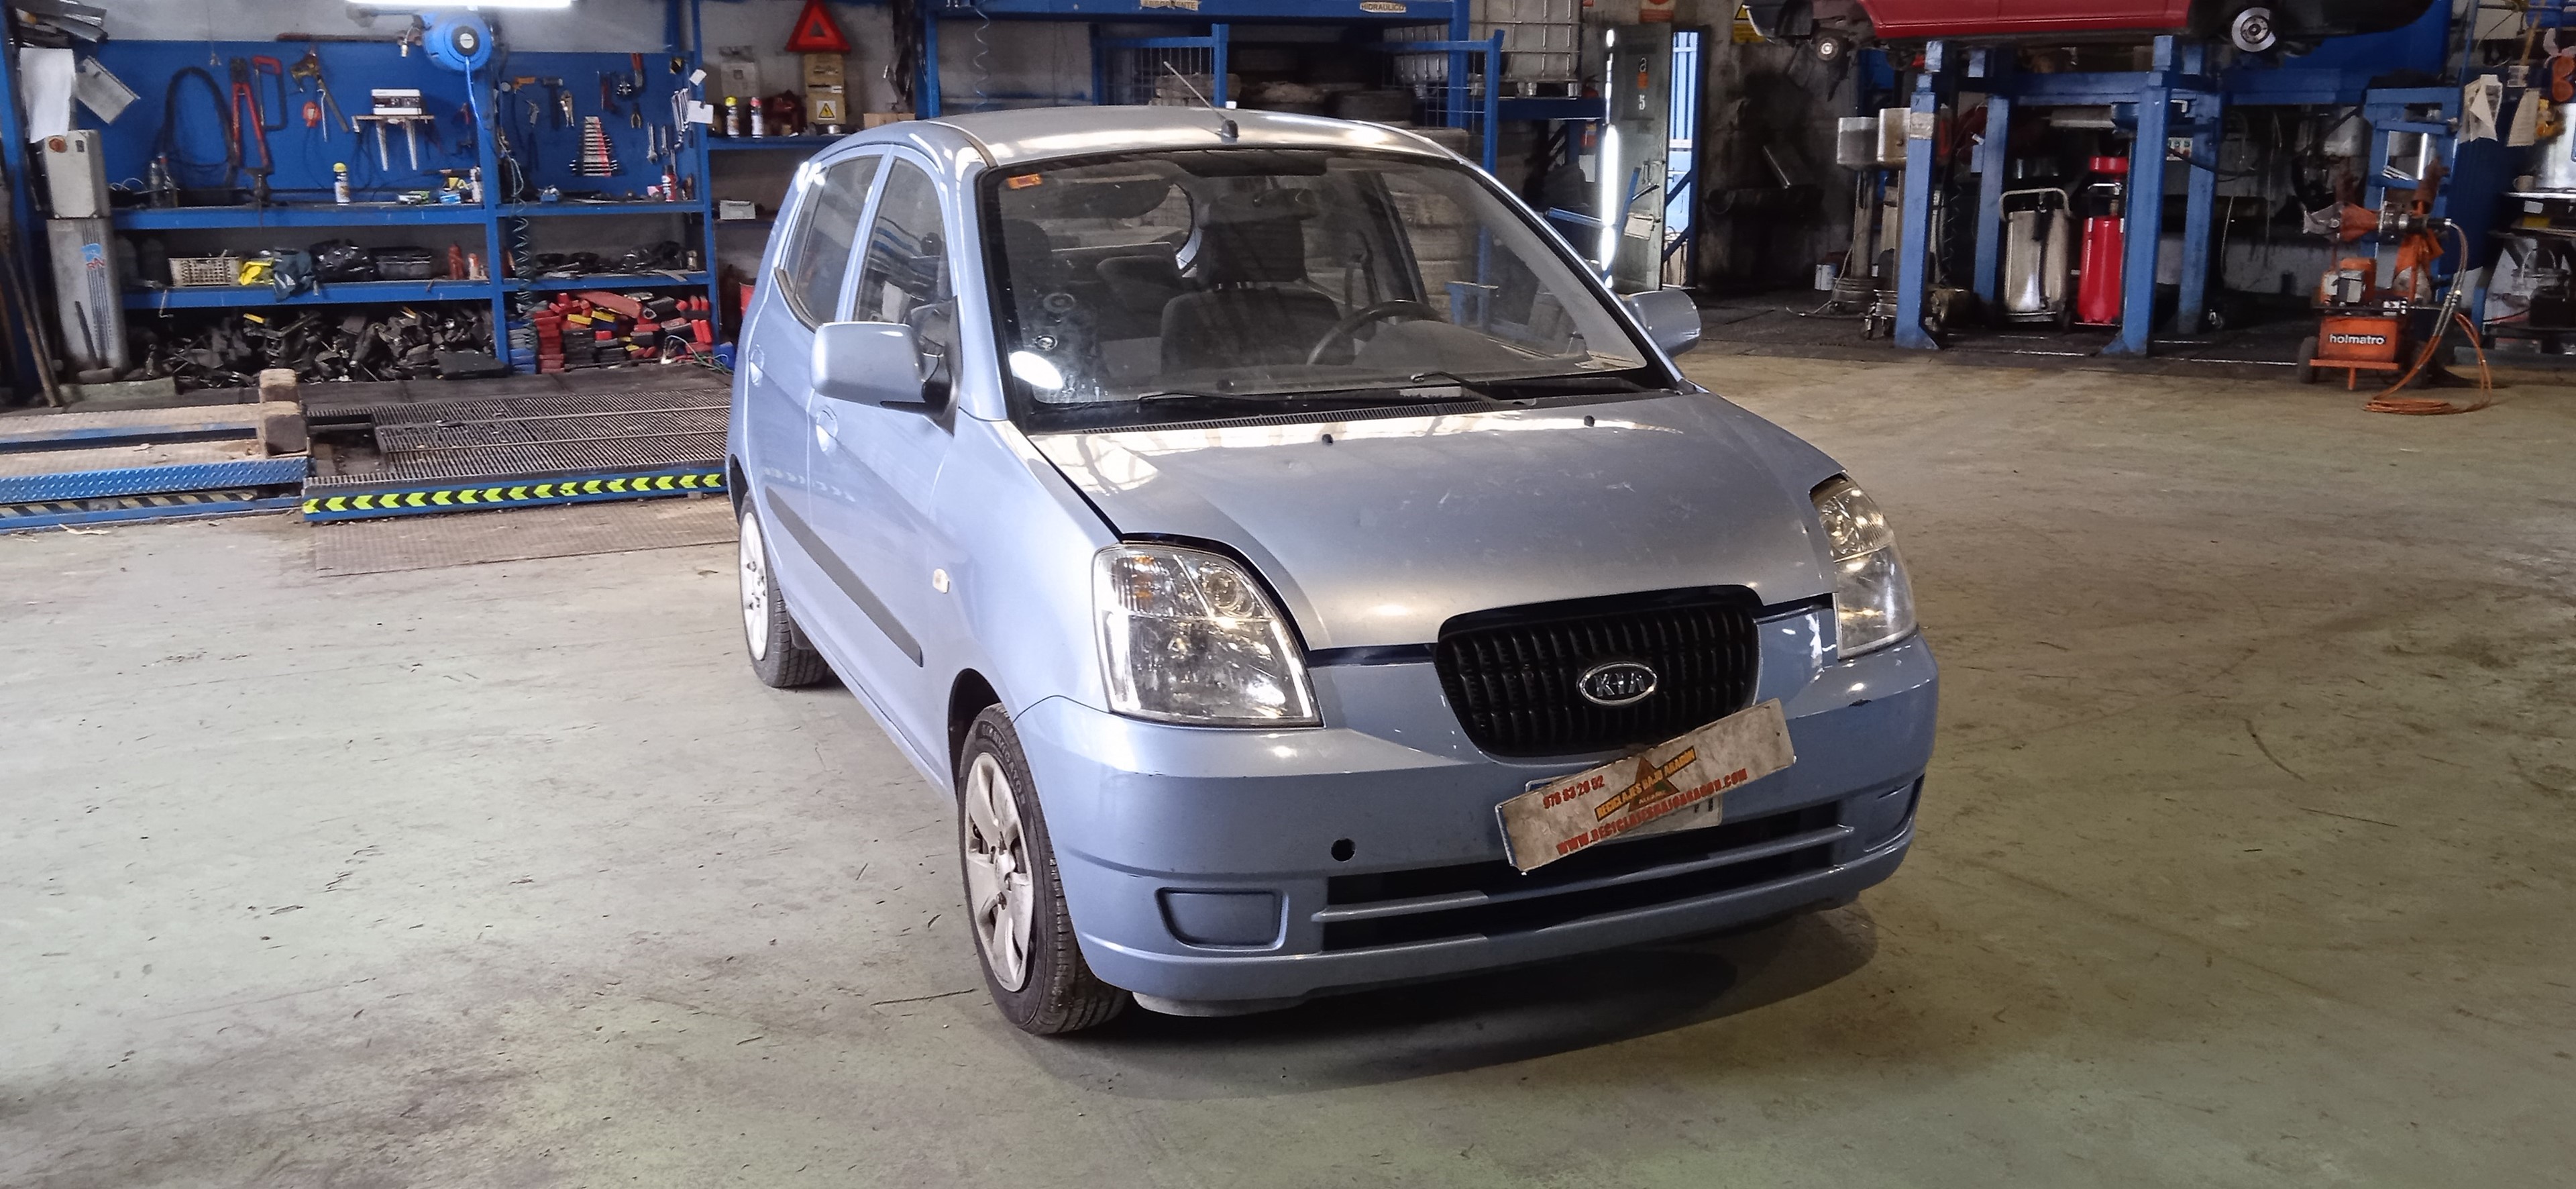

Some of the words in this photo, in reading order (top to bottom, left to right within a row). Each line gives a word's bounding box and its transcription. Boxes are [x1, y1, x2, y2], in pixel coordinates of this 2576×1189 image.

[2329, 333, 2385, 345] holmatro
[1594, 672, 1646, 697] KIA
[1642, 770, 1663, 789] BAJO
